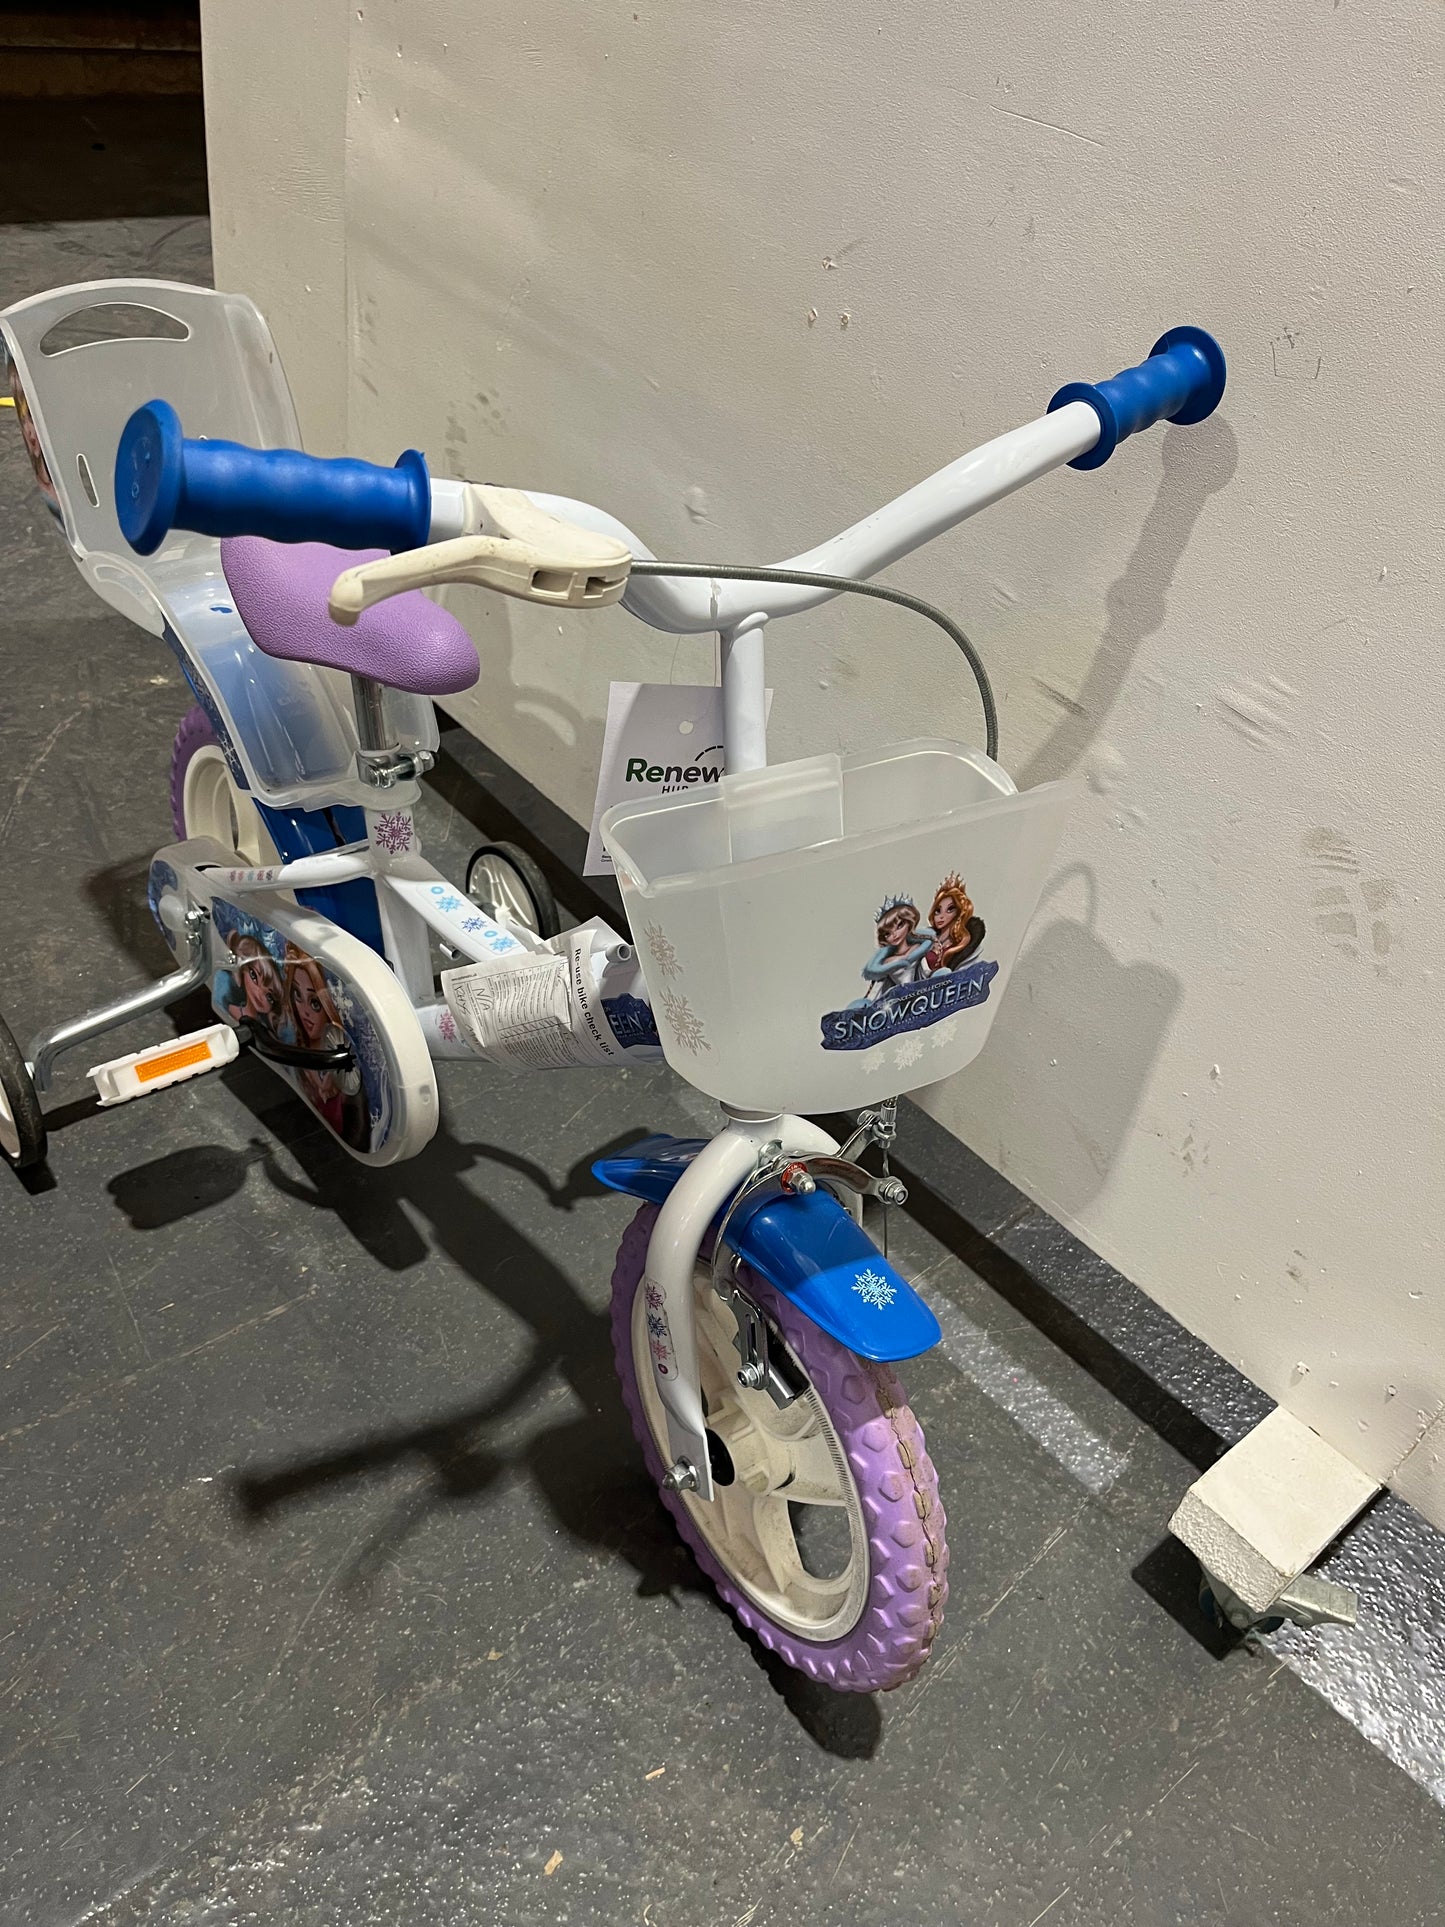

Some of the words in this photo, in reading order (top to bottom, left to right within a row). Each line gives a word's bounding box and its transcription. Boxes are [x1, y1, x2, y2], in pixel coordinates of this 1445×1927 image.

[574, 948, 582, 986] Re-use
[472, 988, 494, 1011] N/A
[577, 986, 588, 1010] bike
[834, 976, 985, 1039] SNOWQUEEN
[584, 1011, 602, 1042] check
[599, 1041, 616, 1056] list
